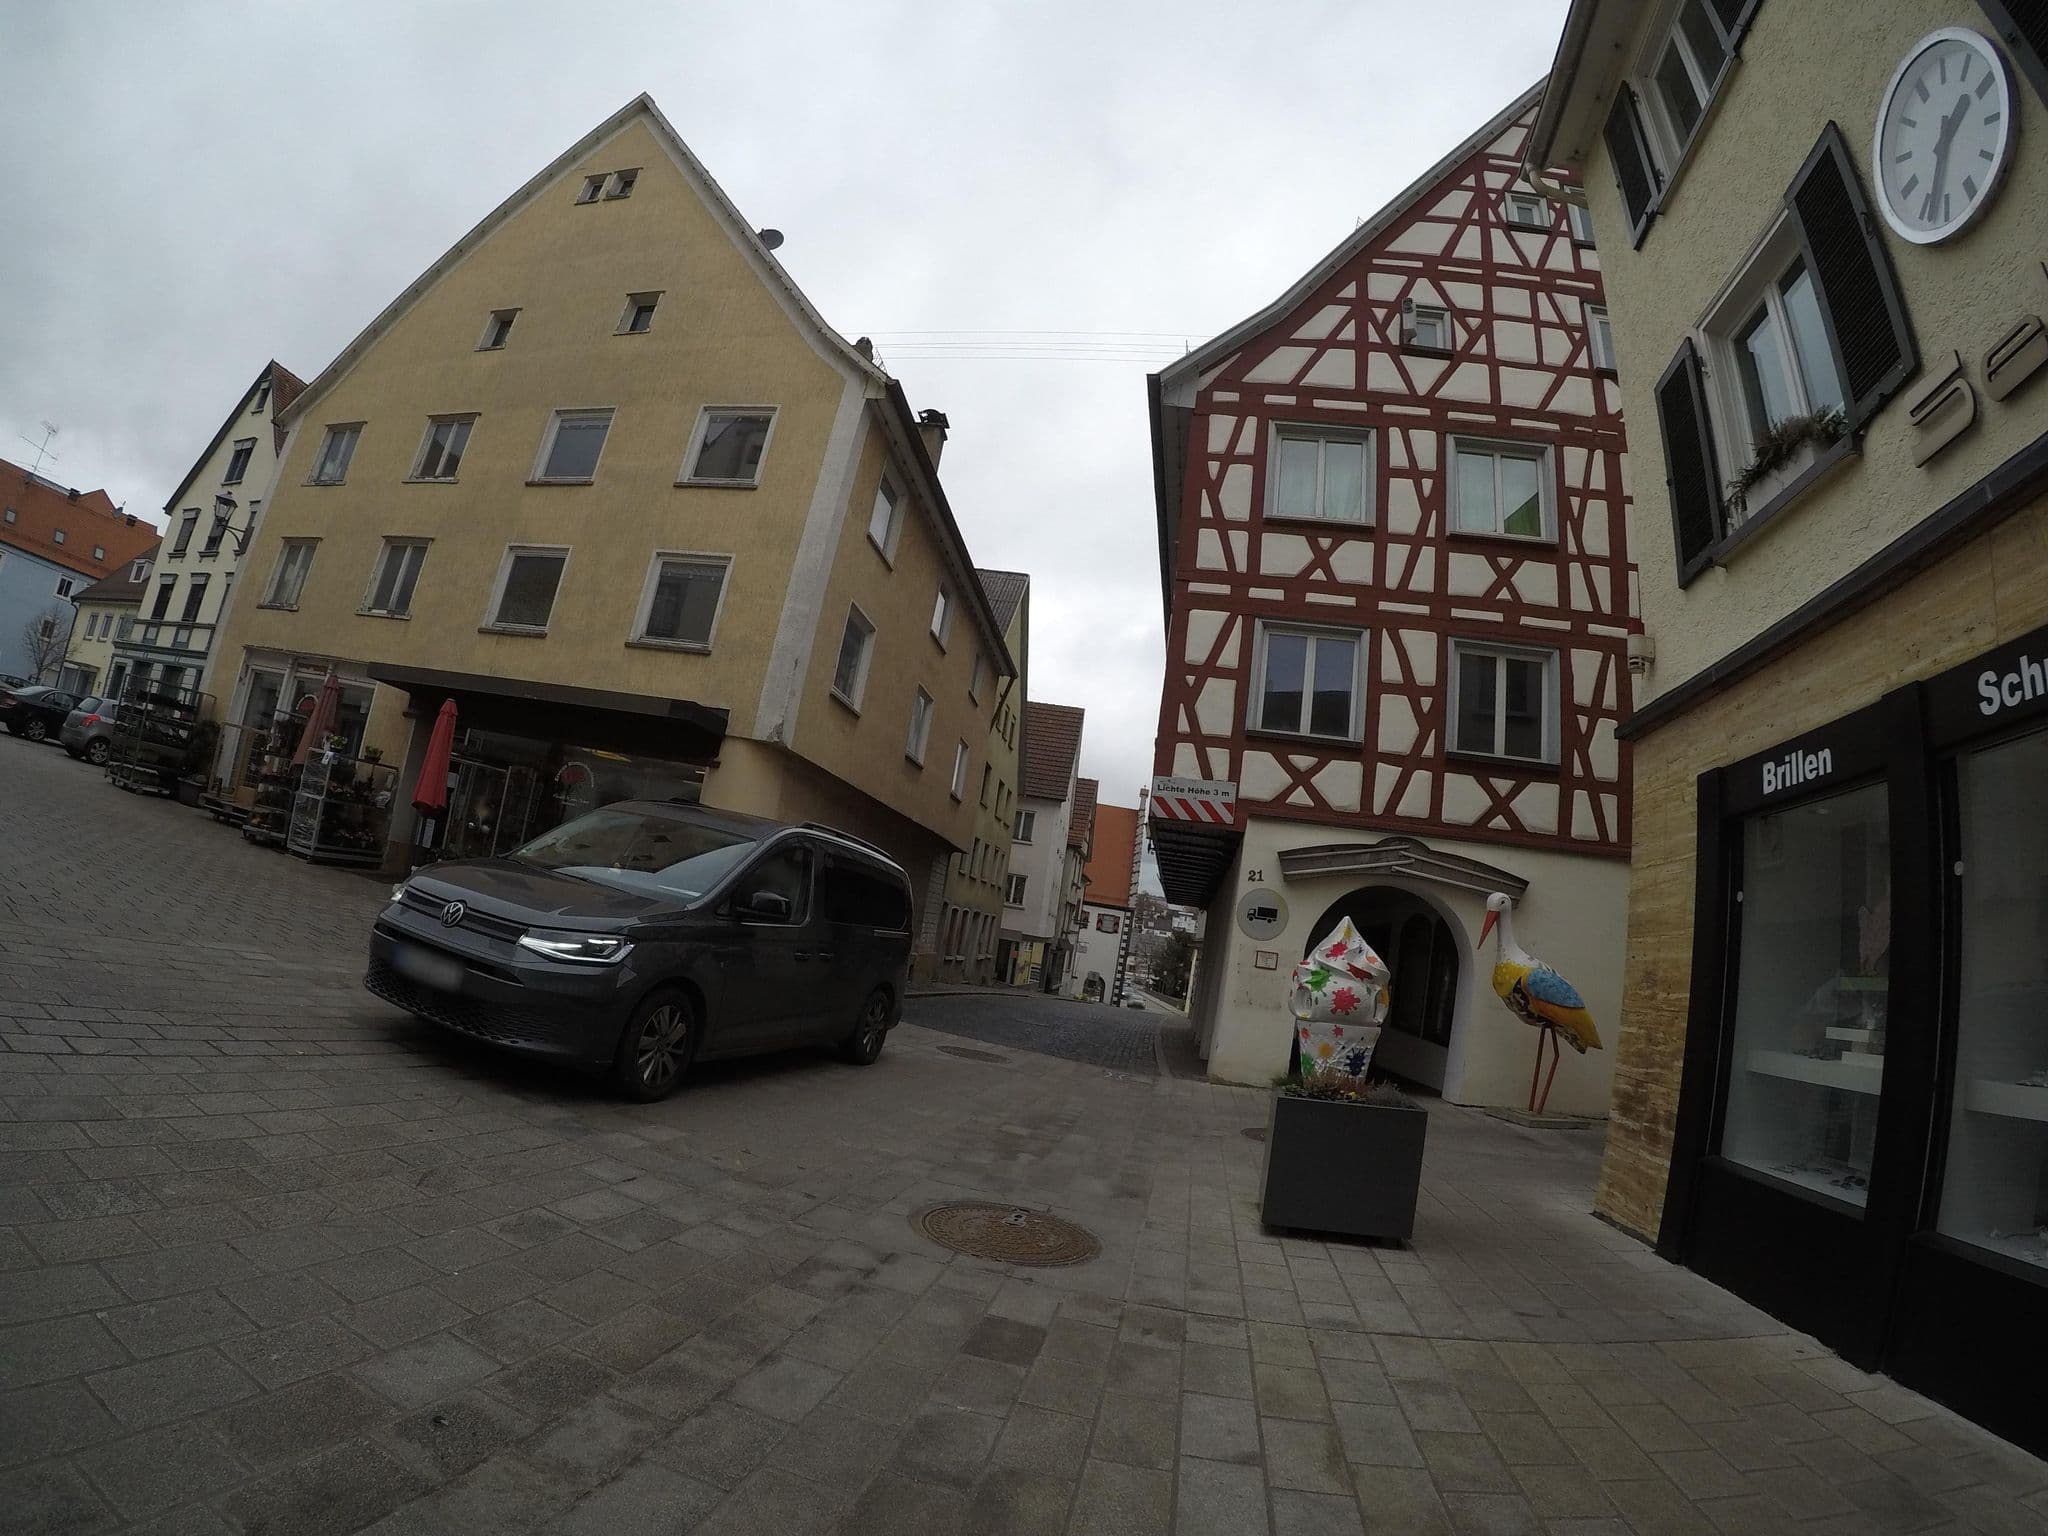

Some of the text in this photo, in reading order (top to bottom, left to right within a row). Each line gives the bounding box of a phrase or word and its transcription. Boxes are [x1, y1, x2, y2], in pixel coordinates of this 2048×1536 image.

[1762, 748, 1832, 795] Brillen
[1157, 784, 1185, 793] Lichte
[1188, 786, 1211, 796] Höhe
[1247, 869, 1264, 882] 21
